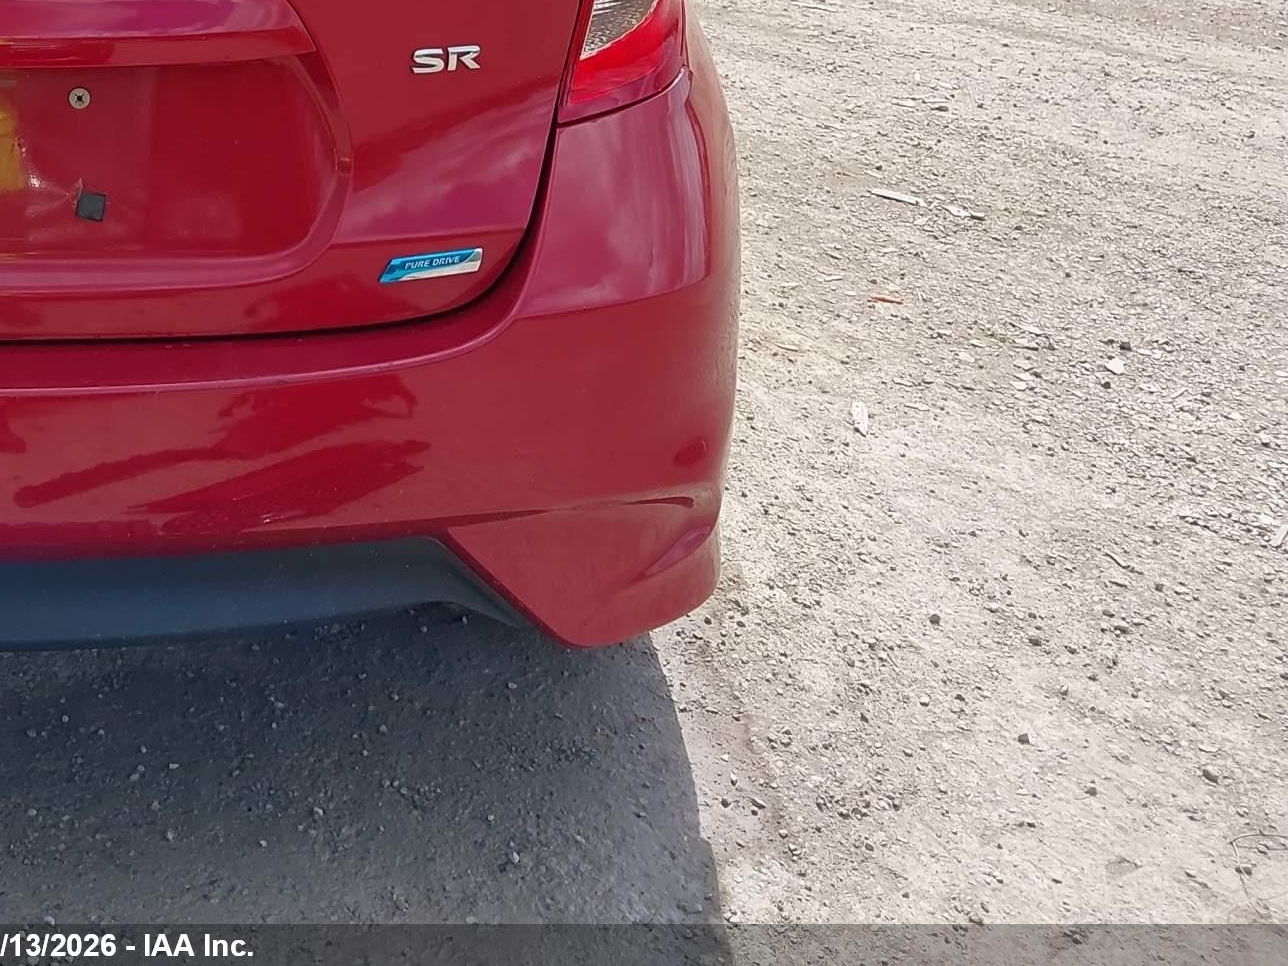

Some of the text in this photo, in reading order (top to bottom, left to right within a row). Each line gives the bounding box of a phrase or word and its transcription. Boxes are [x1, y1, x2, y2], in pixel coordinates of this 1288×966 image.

[412, 45, 481, 74] SR
[404, 255, 461, 270] PURE DRIVE
